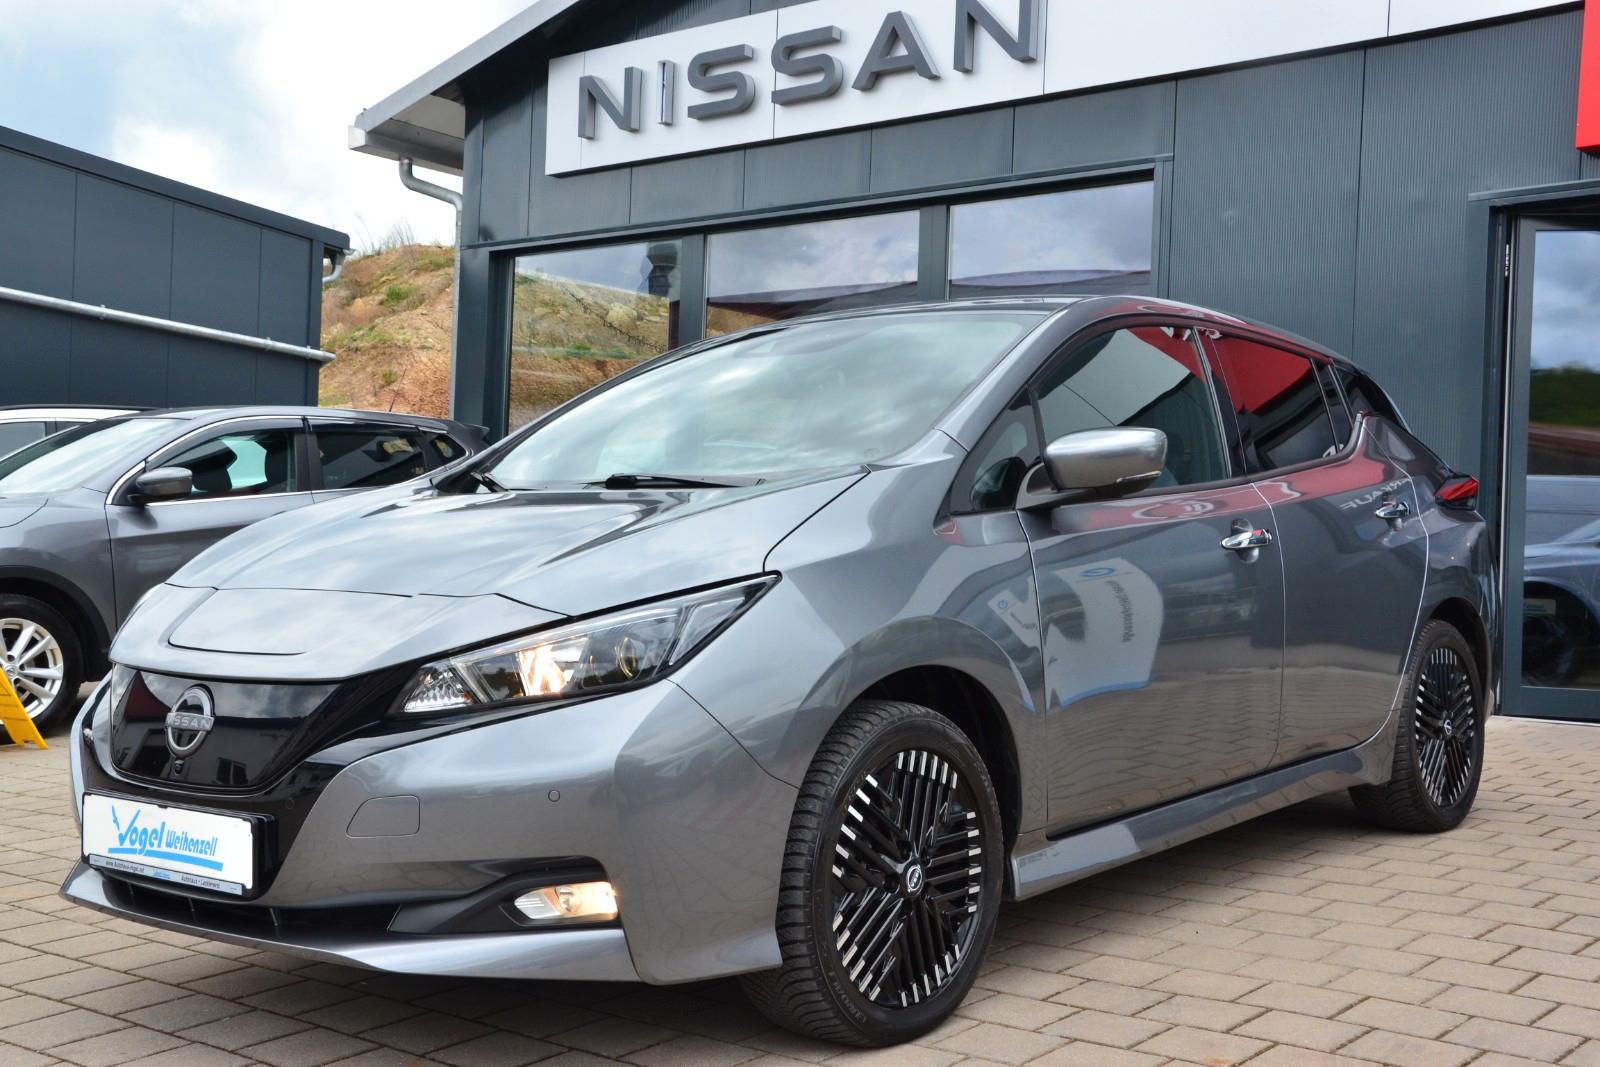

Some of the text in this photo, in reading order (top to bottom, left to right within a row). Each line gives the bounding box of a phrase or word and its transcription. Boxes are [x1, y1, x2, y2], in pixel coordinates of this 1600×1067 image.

[577, 0, 1037, 139] NISSAN
[111, 804, 218, 857] Vogel Weihenzell
